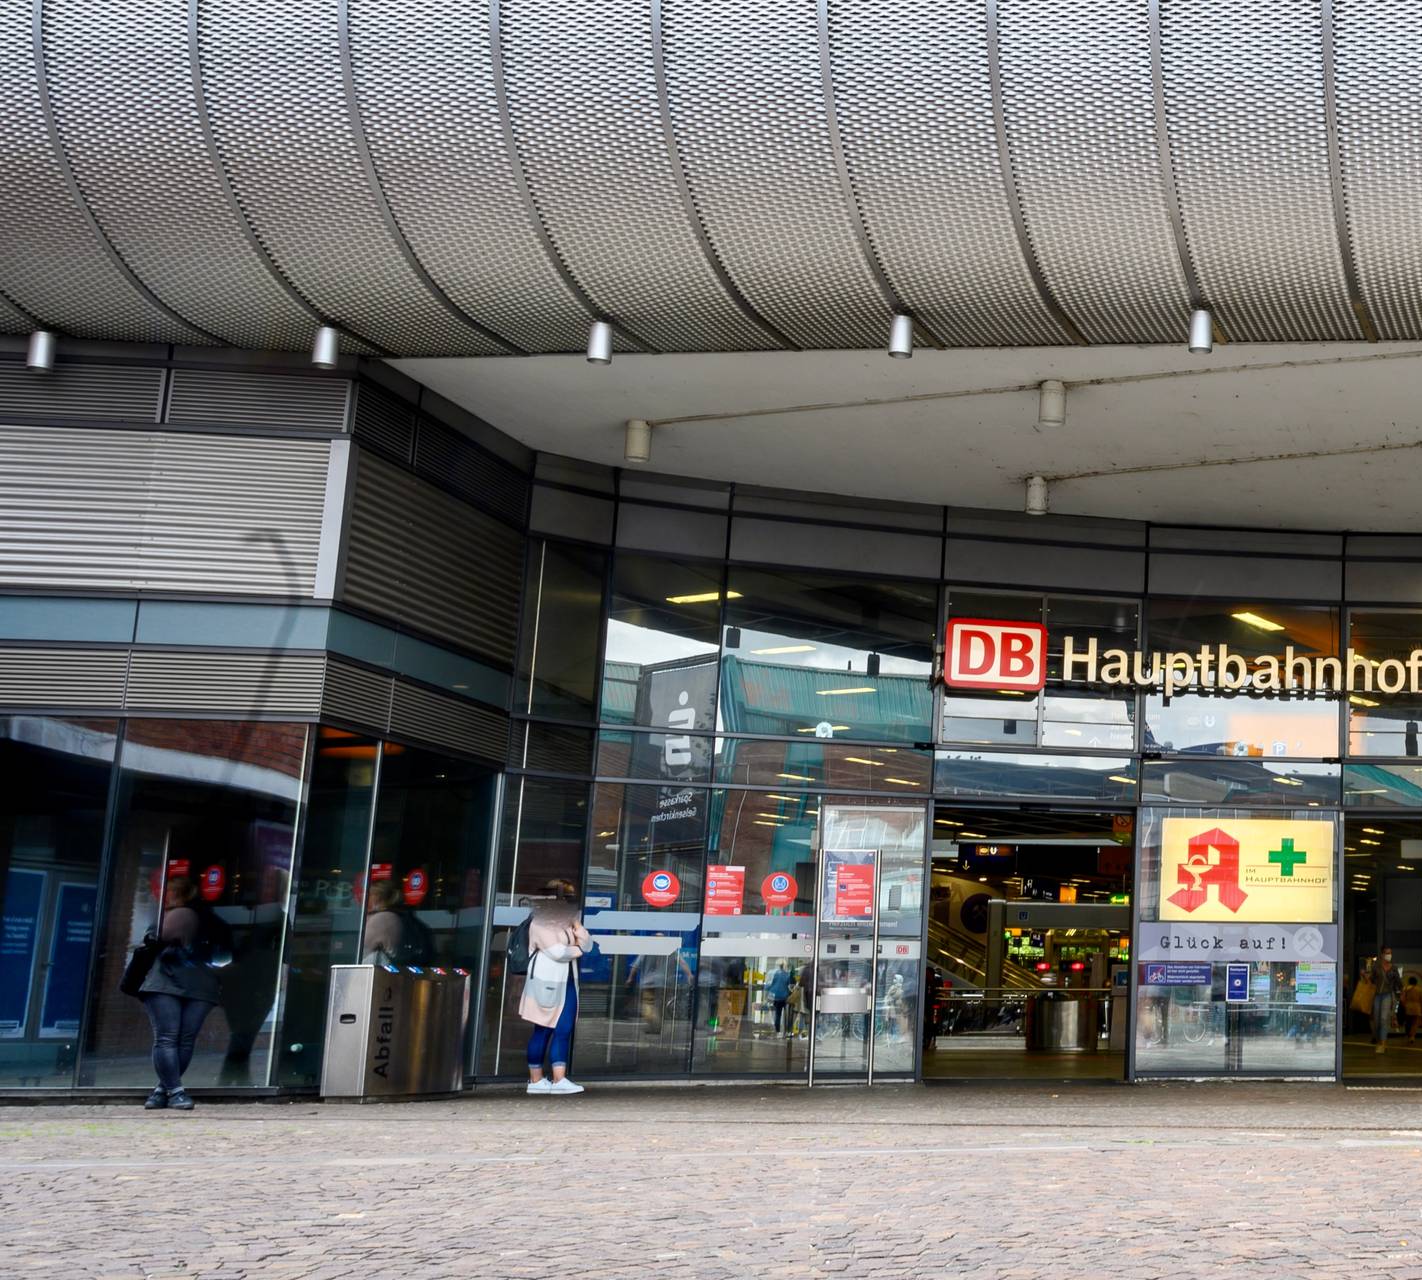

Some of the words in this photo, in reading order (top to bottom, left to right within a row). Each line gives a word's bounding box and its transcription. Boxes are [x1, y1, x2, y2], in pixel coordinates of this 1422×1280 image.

[957, 629, 1034, 676] DB
[1159, 935, 1224, 950] Glück
[1239, 936, 1287, 950] auf!
[373, 1006, 394, 1080] Abfall
